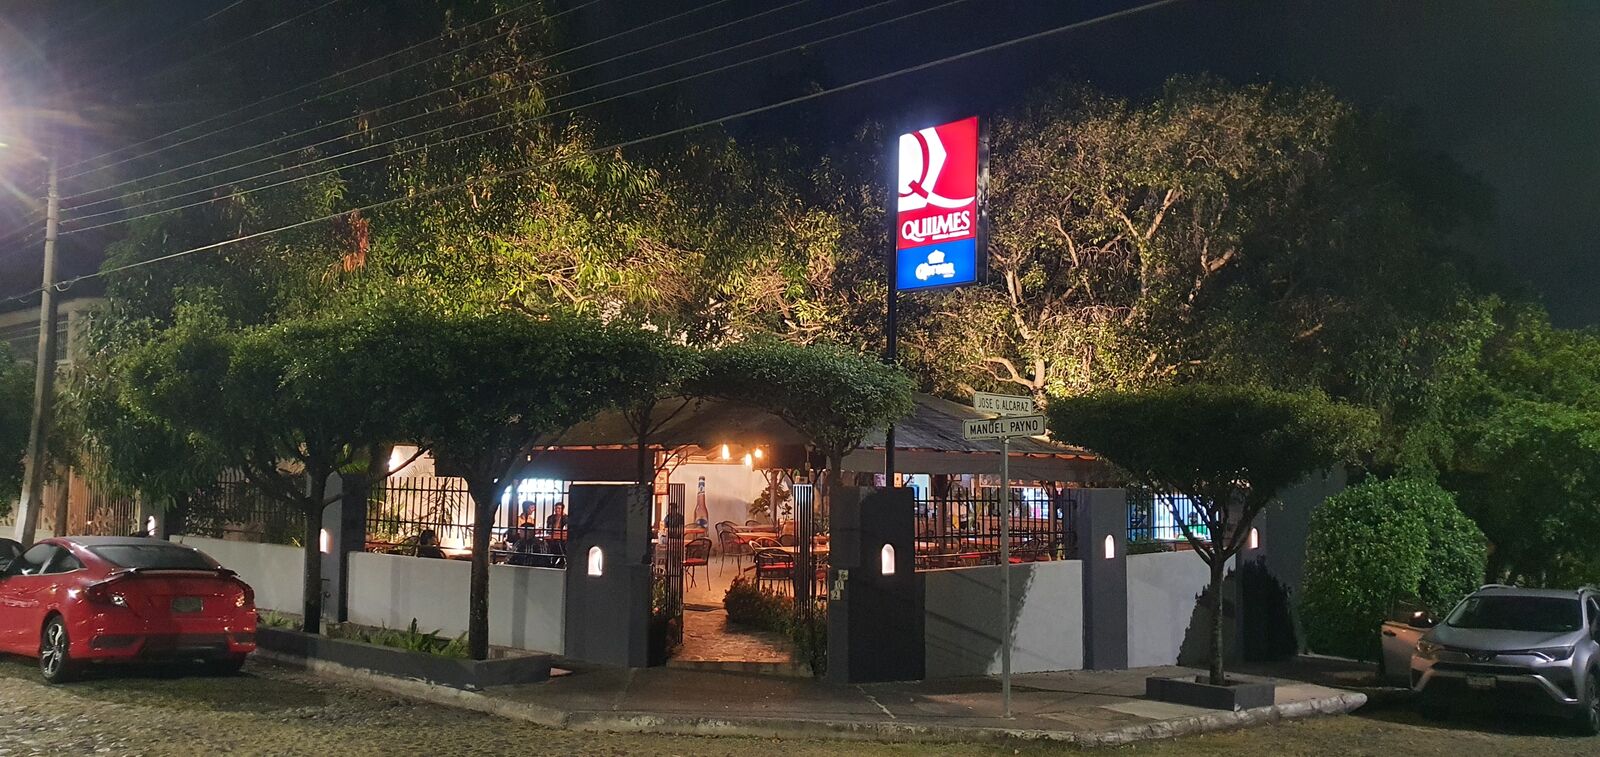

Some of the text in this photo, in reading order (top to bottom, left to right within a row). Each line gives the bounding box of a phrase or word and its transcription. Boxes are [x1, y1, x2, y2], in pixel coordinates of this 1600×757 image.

[978, 397, 993, 410] JOSE
[1002, 399, 1029, 412] ALCARAZ
[970, 420, 1039, 435] MANUEL PAYNO
